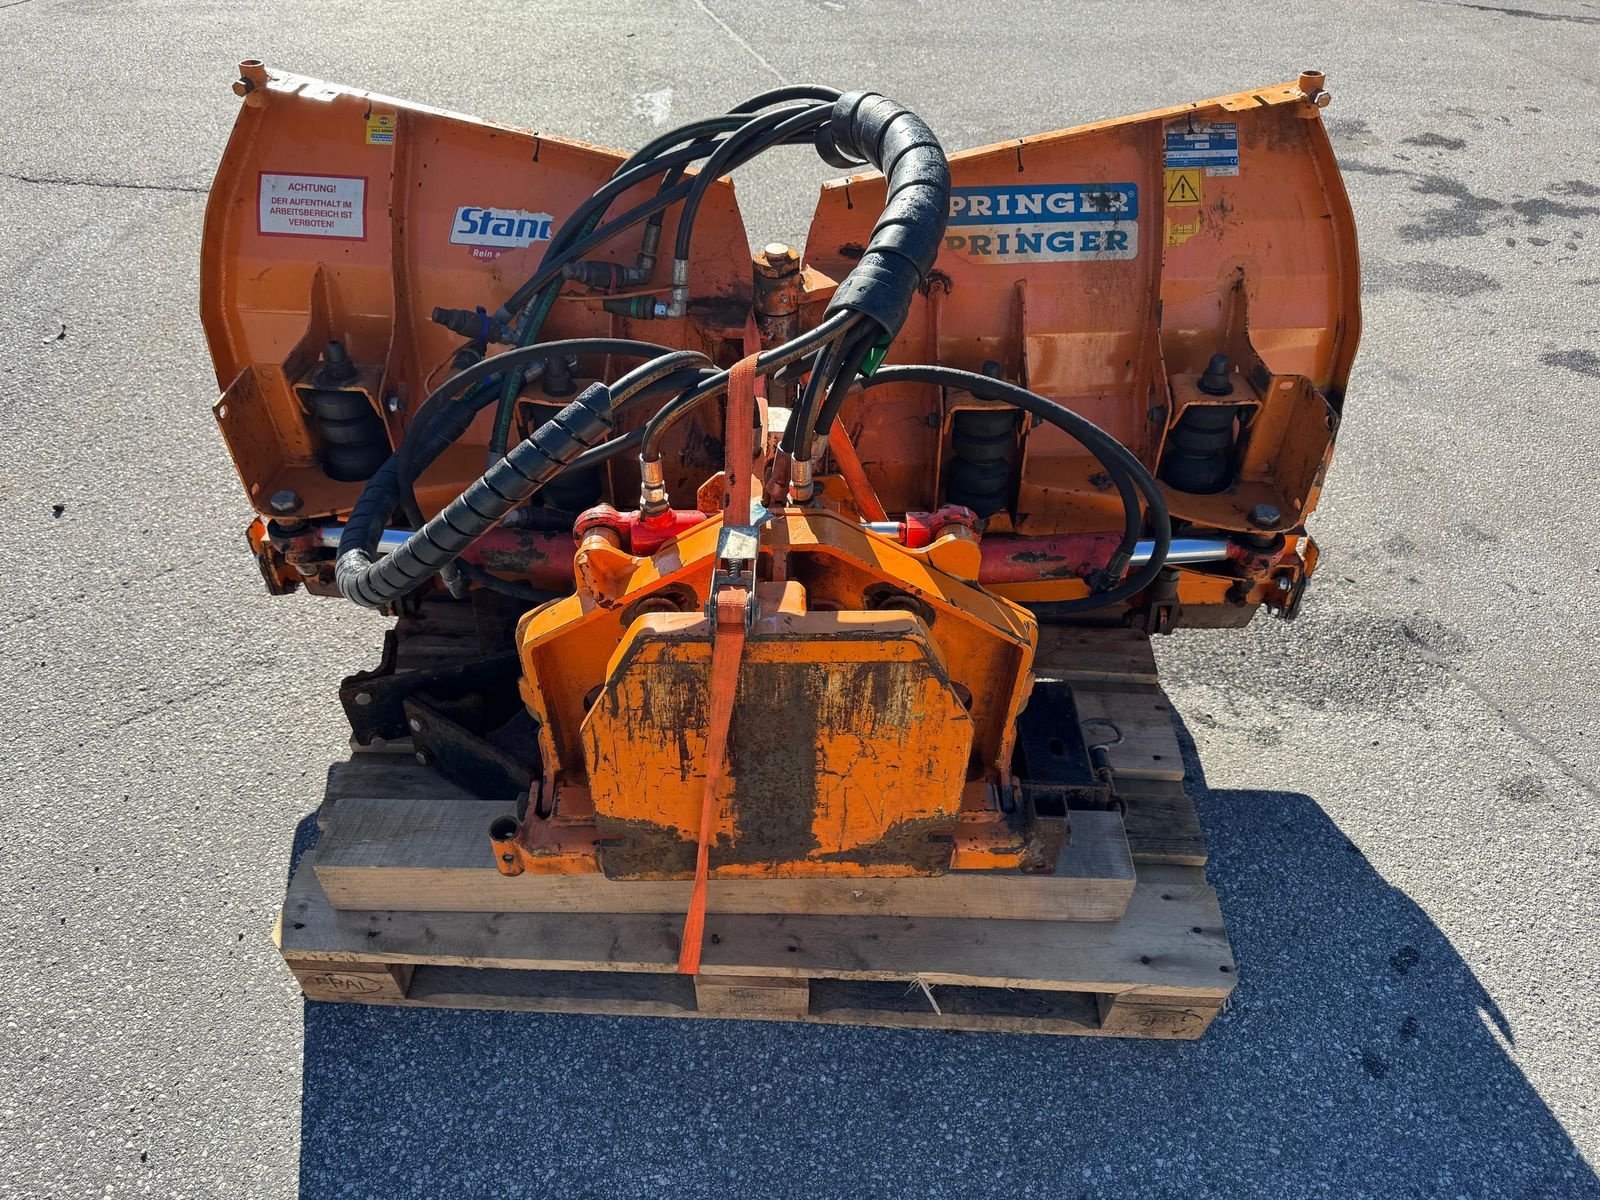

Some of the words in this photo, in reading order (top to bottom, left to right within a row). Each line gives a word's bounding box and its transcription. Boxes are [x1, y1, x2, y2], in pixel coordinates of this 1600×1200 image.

[288, 183, 336, 193] ACHTUNG!
[271, 197, 288, 205] DER
[289, 198, 341, 208] AUFENTHALT
[949, 192, 1128, 217] PRINGER
[270, 207, 339, 218] ARBEITSBEREICH
[340, 211, 353, 219] IST
[288, 219, 335, 228] VERBOTEN!
[944, 230, 1128, 256] PRINGER
[473, 249, 493, 258] Rein
